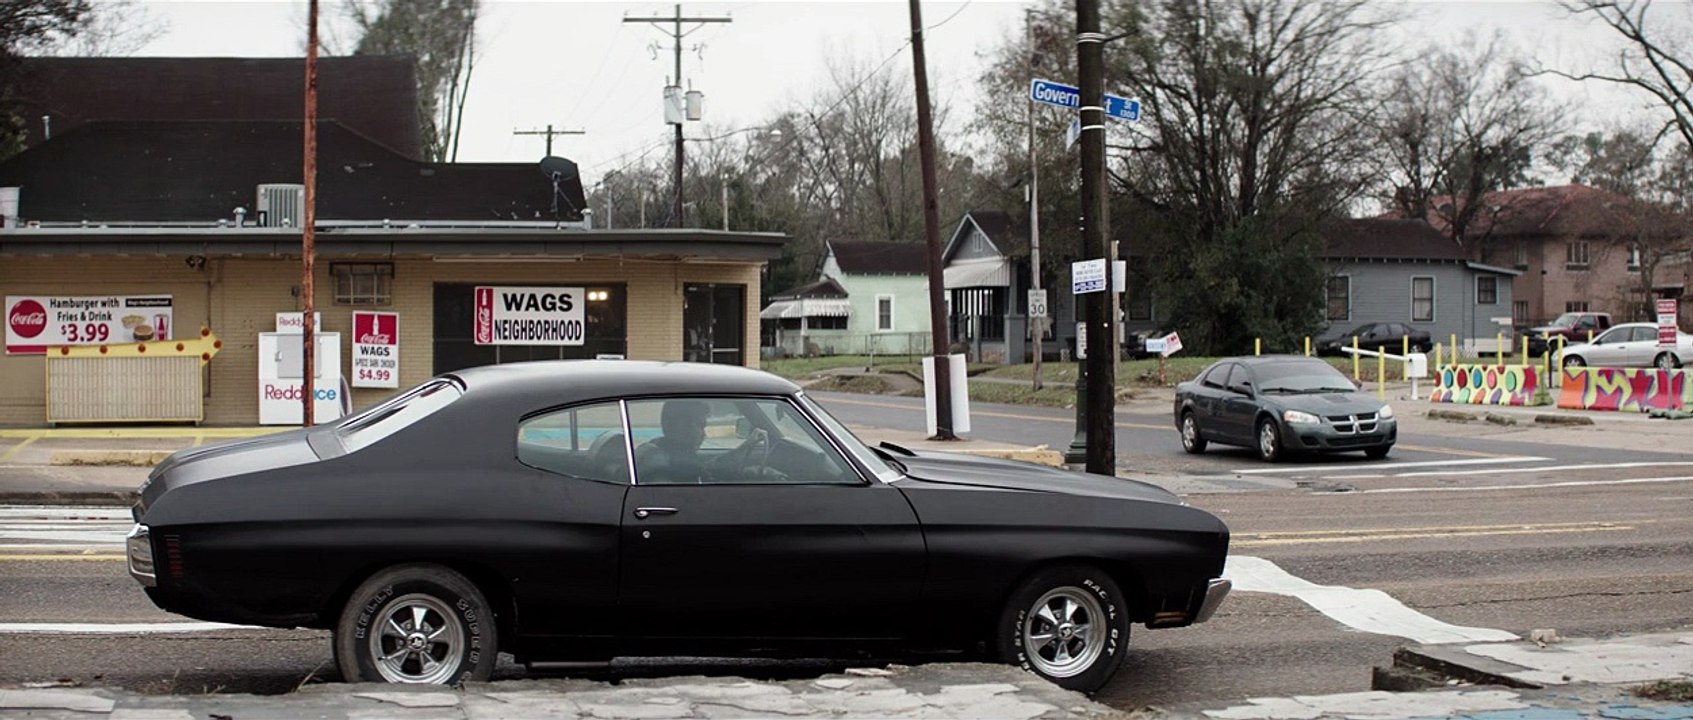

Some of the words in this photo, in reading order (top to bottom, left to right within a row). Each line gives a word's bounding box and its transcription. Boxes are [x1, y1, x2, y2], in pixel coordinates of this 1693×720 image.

[1035, 82, 1111, 114] Governt
[50, 299, 98, 310] Hamburger
[101, 298, 119, 308] with
[502, 293, 573, 312] WAGS
[1030, 304, 1045, 315] 30
[11, 312, 45, 325] Coca-Cola
[57, 311, 78, 322] Fries
[80, 311, 86, 321] &
[88, 311, 112, 321] Drink
[478, 306, 490, 342] Coca-Cola
[61, 323, 109, 342] $3.99
[494, 319, 582, 341] NEIGHBORHOOD
[360, 333, 390, 345] Coca-Cola
[360, 346, 390, 357] WAGS
[359, 369, 391, 381] $4.99
[265, 384, 306, 401] Redd
[355, 585, 394, 640] KELLY
[456, 598, 480, 664] SUPER
